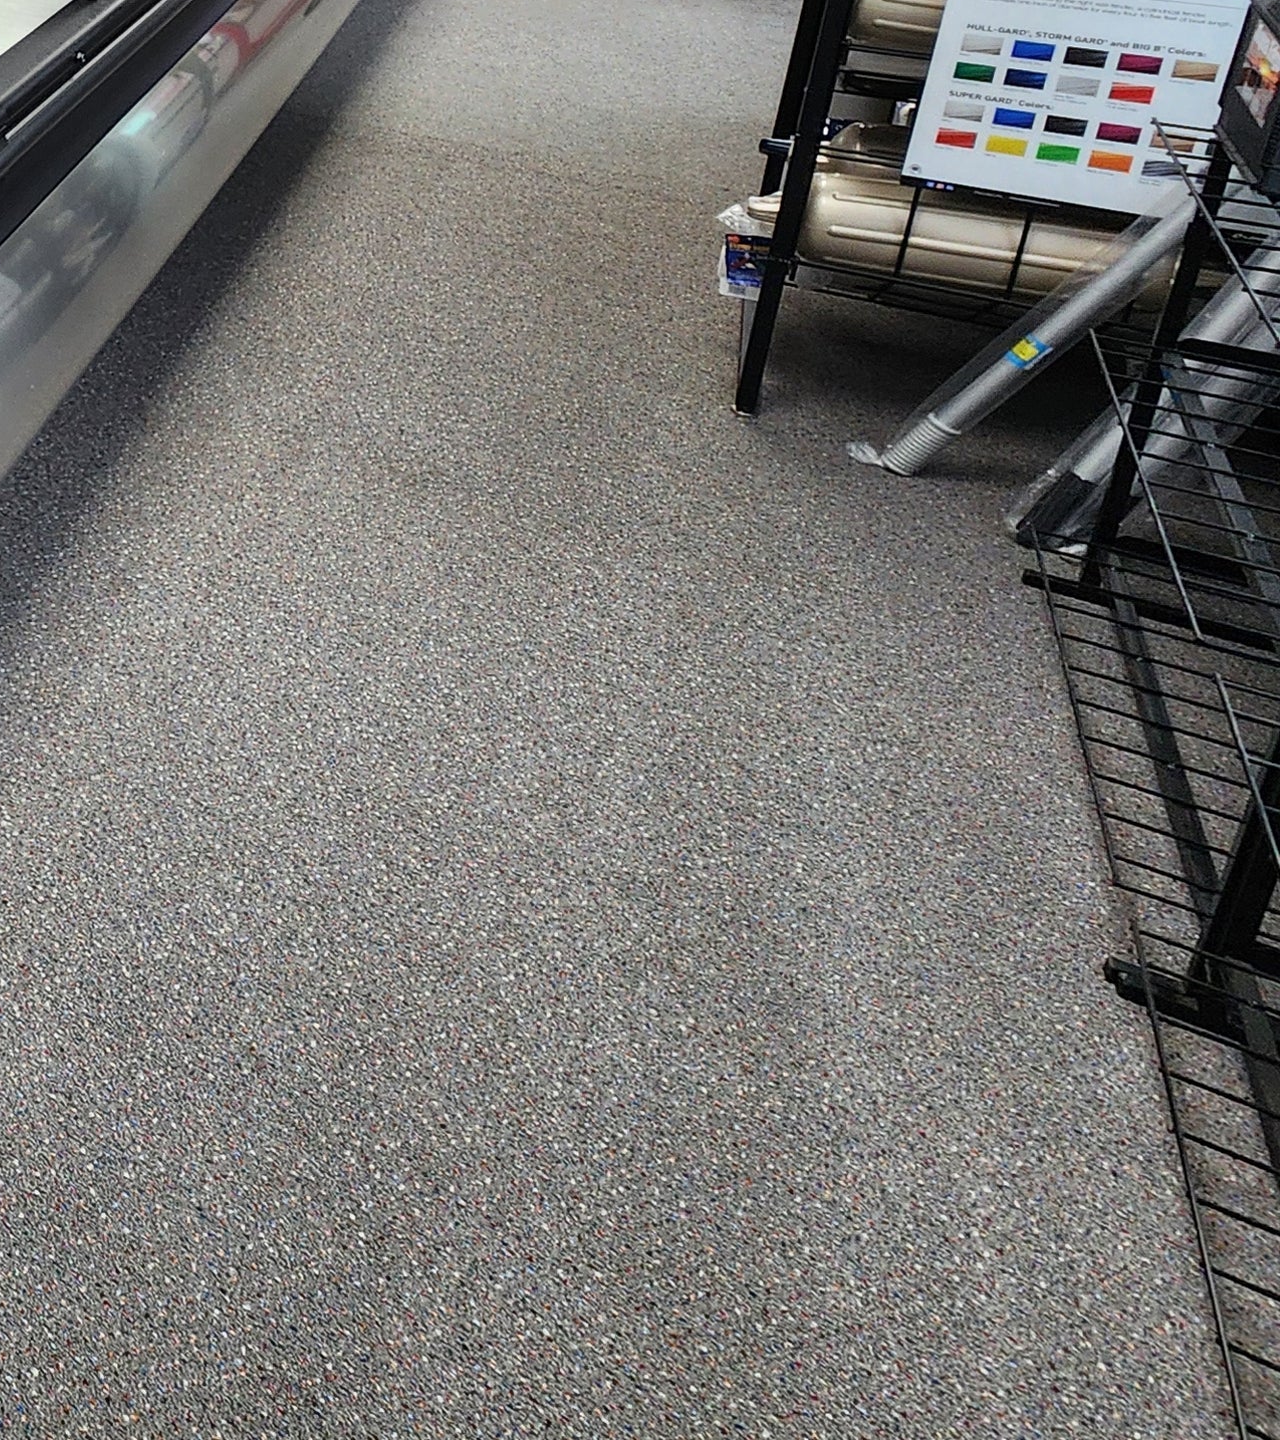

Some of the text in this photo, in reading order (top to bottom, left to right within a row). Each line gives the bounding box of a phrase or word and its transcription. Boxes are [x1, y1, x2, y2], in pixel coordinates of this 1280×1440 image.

[1035, 30, 1072, 41] STORM
[1110, 40, 1130, 49] and
[1132, 43, 1151, 51] BIG
[1168, 46, 1207, 58] Colors:
[949, 90, 982, 101] SUPER
